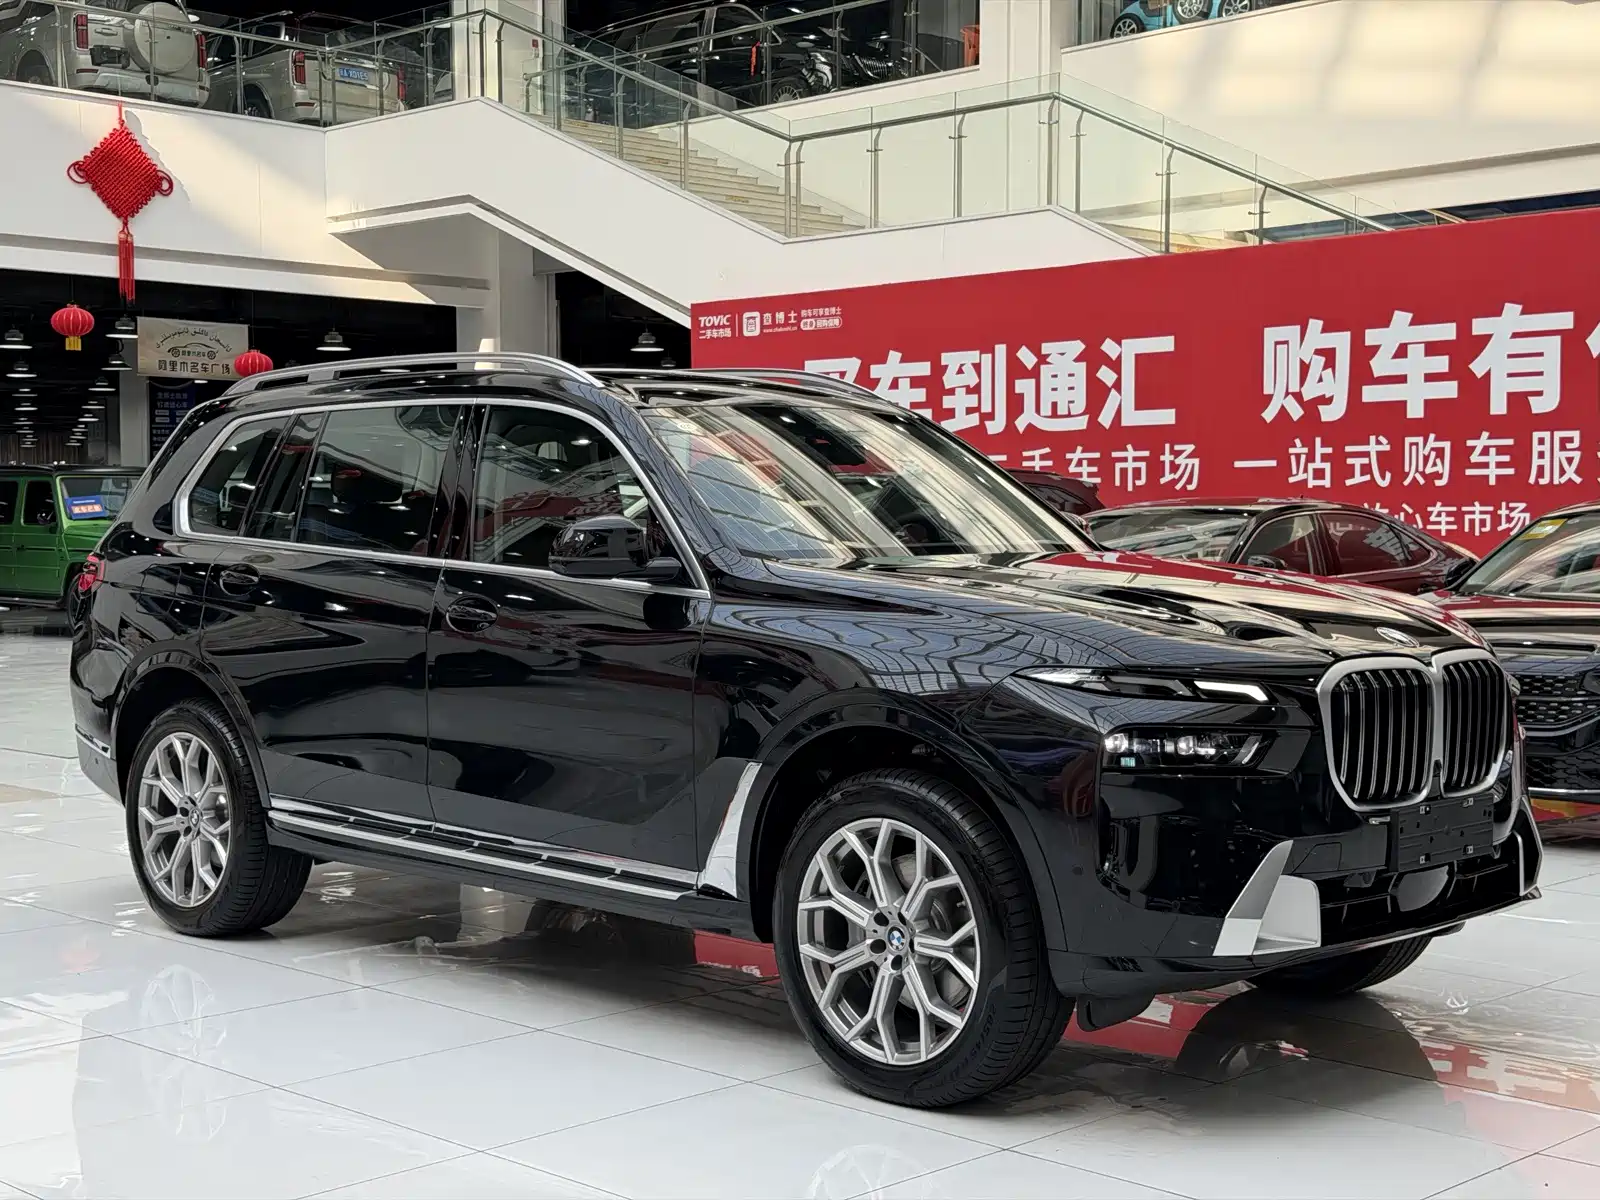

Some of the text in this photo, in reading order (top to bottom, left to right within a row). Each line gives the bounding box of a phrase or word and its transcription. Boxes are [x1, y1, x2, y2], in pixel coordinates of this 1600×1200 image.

[763, 310, 798, 326] 查博士
[698, 328, 732, 339] 二手车市场
[158, 359, 230, 375] 阿里木名车广场
[804, 302, 1600, 434] 车到通汇 购车有
[988, 430, 1600, 492] 手车市场 一站式购车服
